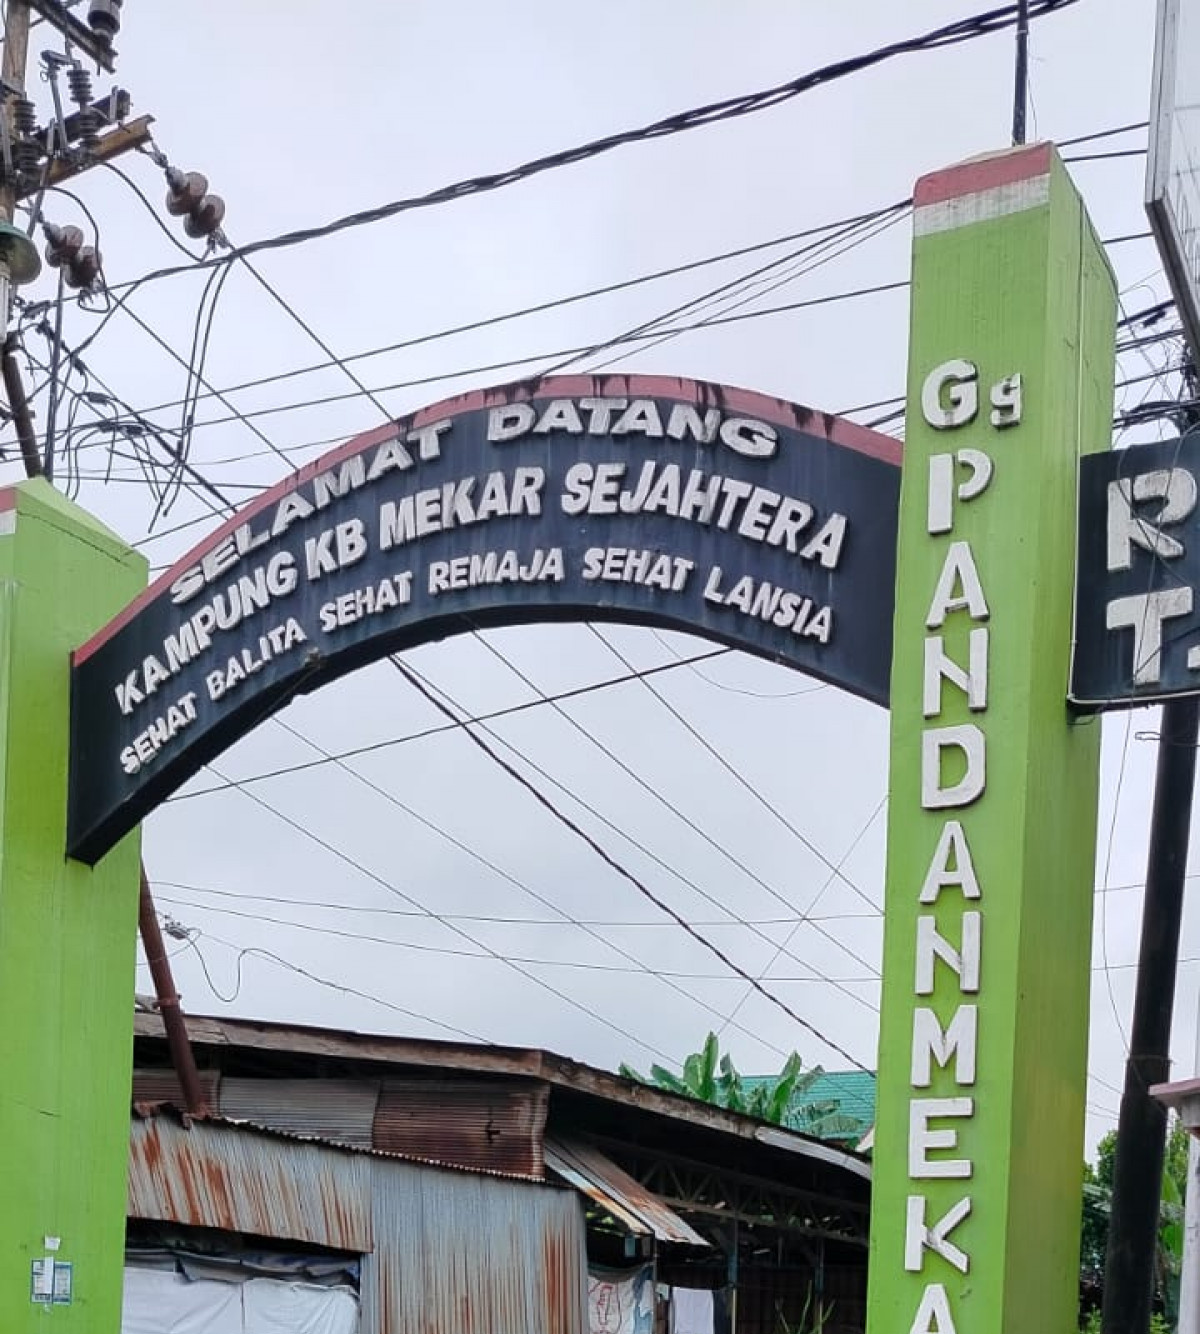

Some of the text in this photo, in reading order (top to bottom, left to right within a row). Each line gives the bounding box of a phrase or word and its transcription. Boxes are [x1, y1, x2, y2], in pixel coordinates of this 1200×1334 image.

[170, 398, 779, 605] SELAMAT DATANG
[921, 359, 1023, 430] Gg
[115, 460, 849, 715] KAMPUNG KB MEKAR SEJAHTERA
[120, 546, 832, 775] SEHAT BALITA SEHAT REMAJA SEHAT LANSIA
